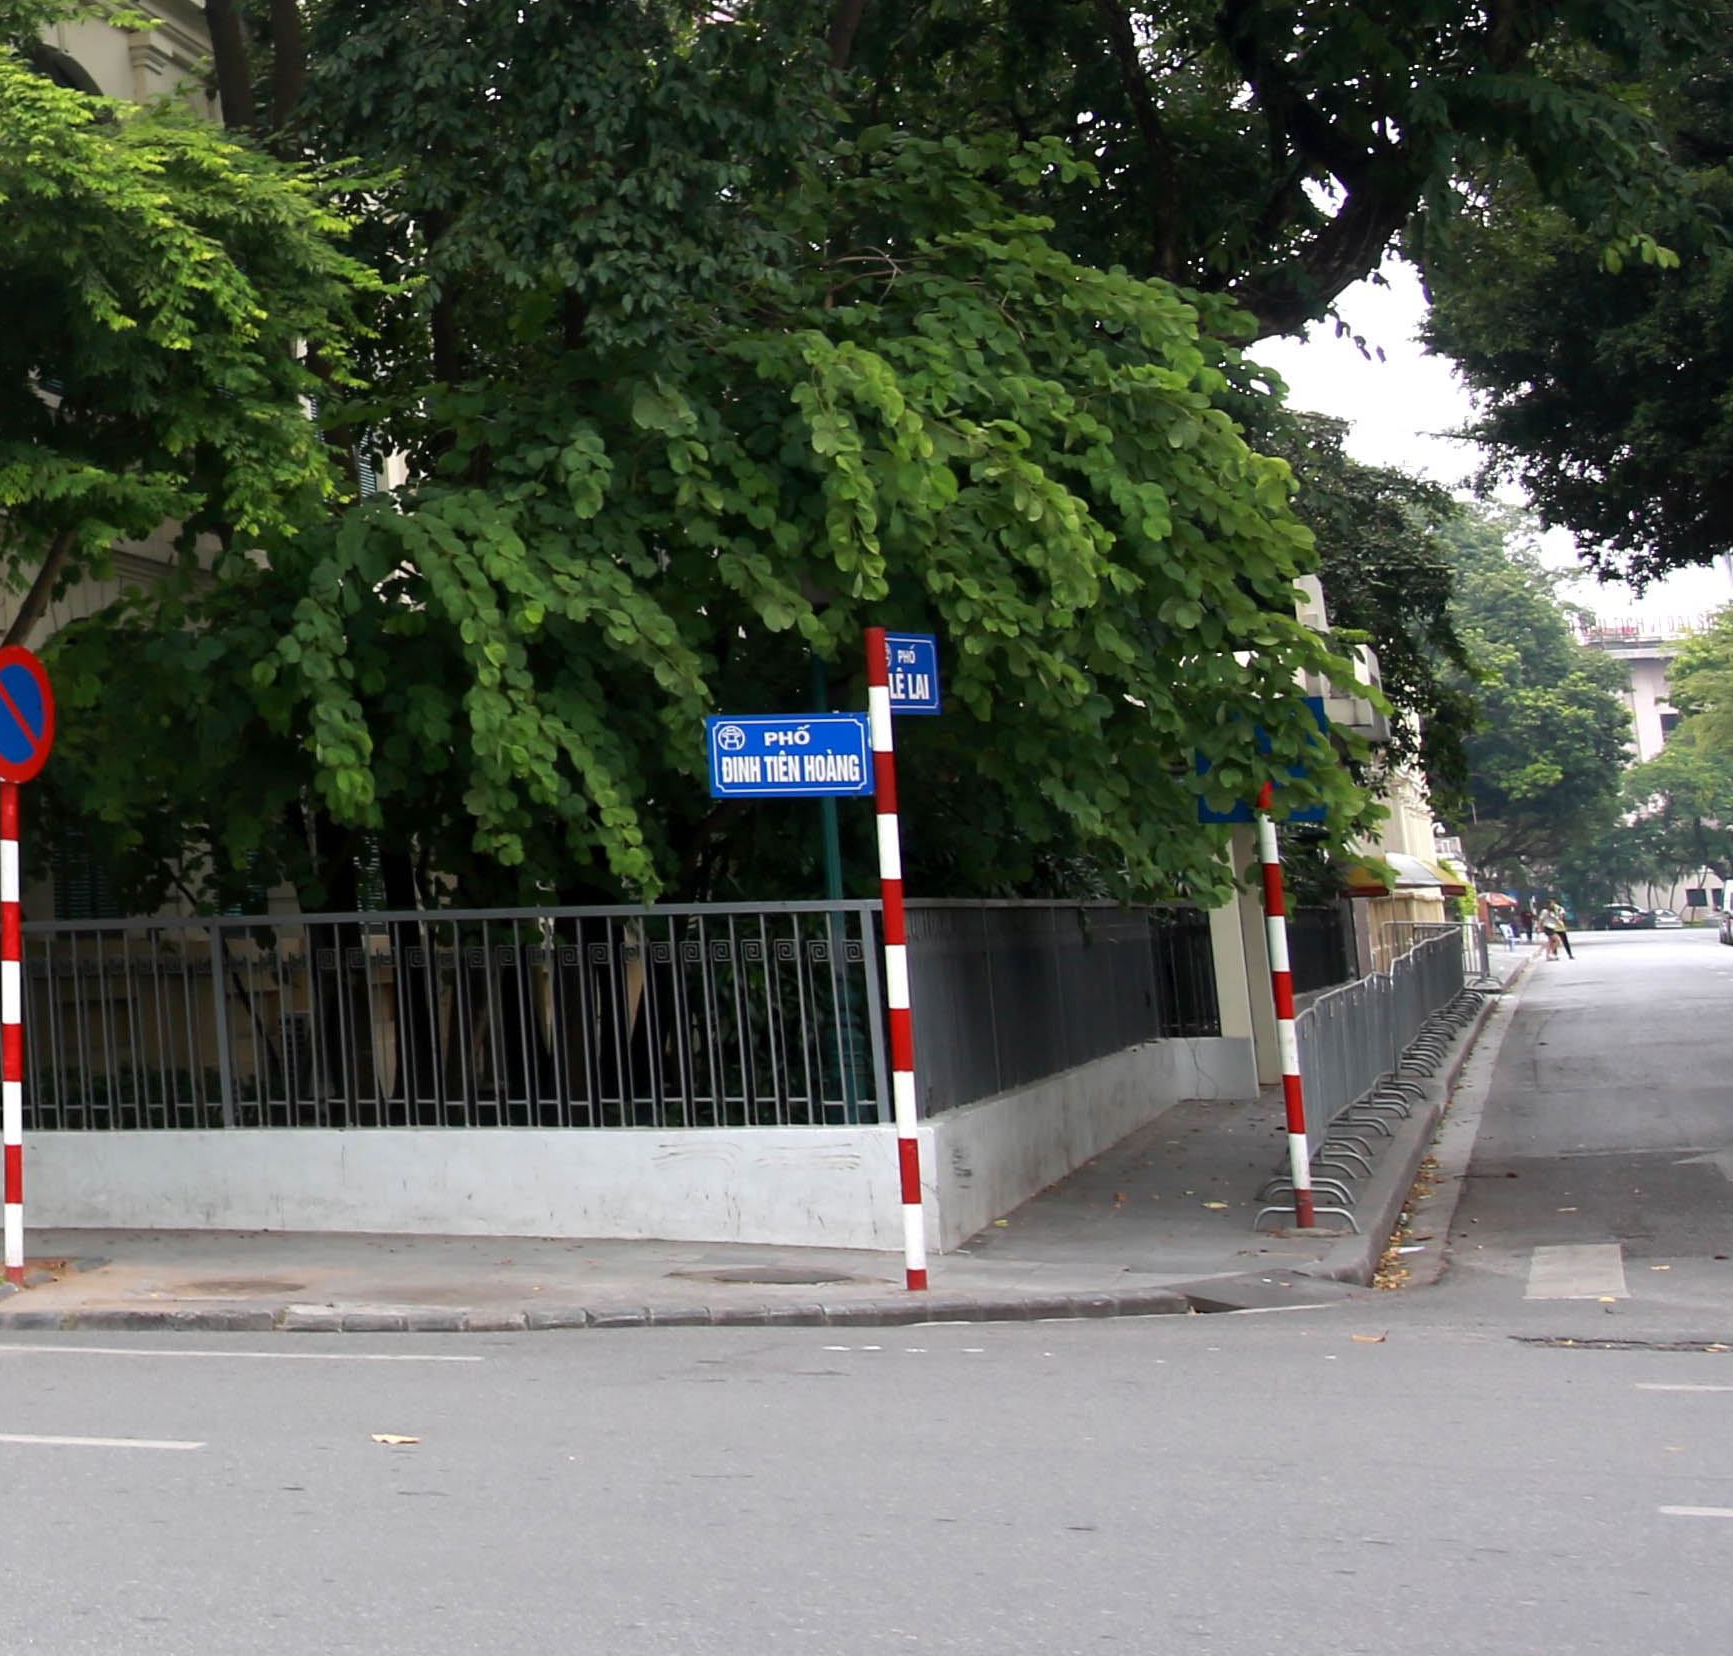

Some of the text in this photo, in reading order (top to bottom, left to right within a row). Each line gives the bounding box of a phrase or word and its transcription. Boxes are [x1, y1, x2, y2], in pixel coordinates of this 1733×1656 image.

[897, 644, 916, 664] PHỐ
[888, 666, 930, 700] LÊ LAI
[764, 724, 811, 746] PHỐ
[722, 748, 861, 783] ĐINH TIÊN HOÀNG
